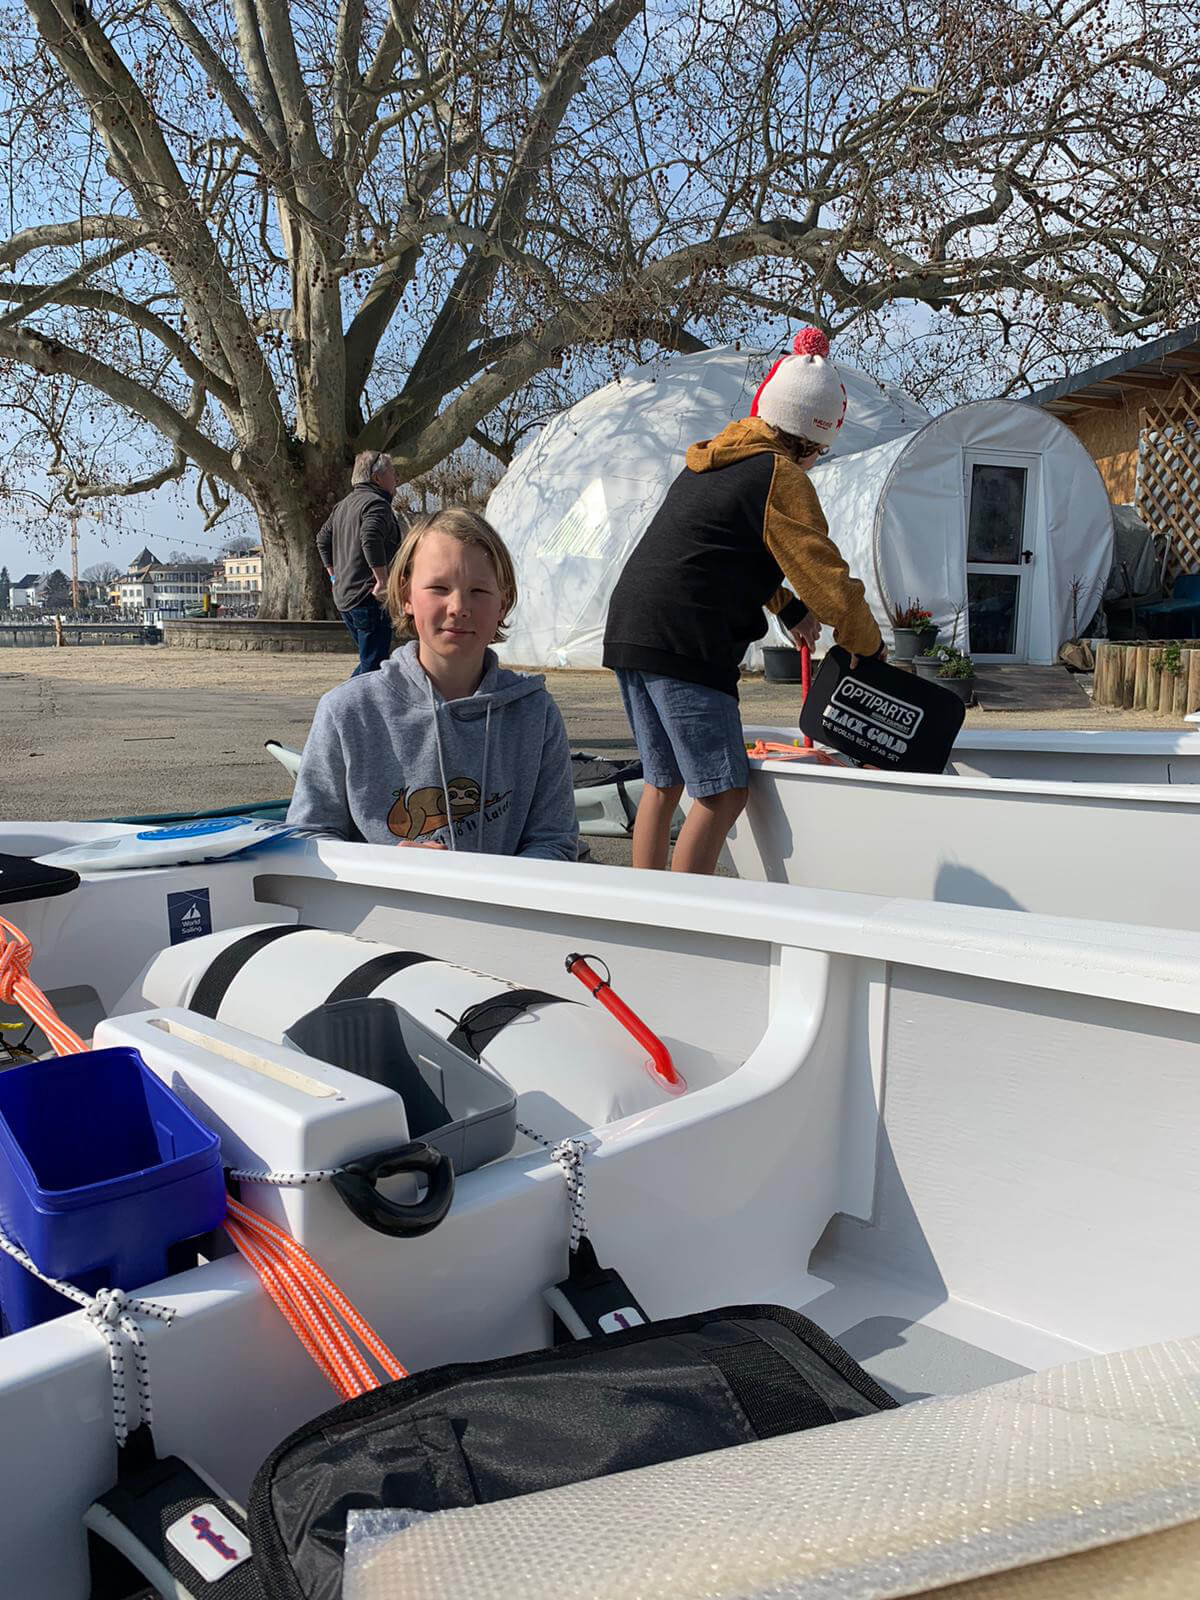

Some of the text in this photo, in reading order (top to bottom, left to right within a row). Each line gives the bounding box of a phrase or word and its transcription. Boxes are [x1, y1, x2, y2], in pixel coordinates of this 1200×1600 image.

[841, 683, 915, 725] OPTIPARTS
[822, 719, 833, 730] THE
[855, 736, 871, 749] BEST
[823, 705, 908, 754] BLACK GOLD
[182, 919, 200, 927] World
[182, 926, 202, 934] Sailing
